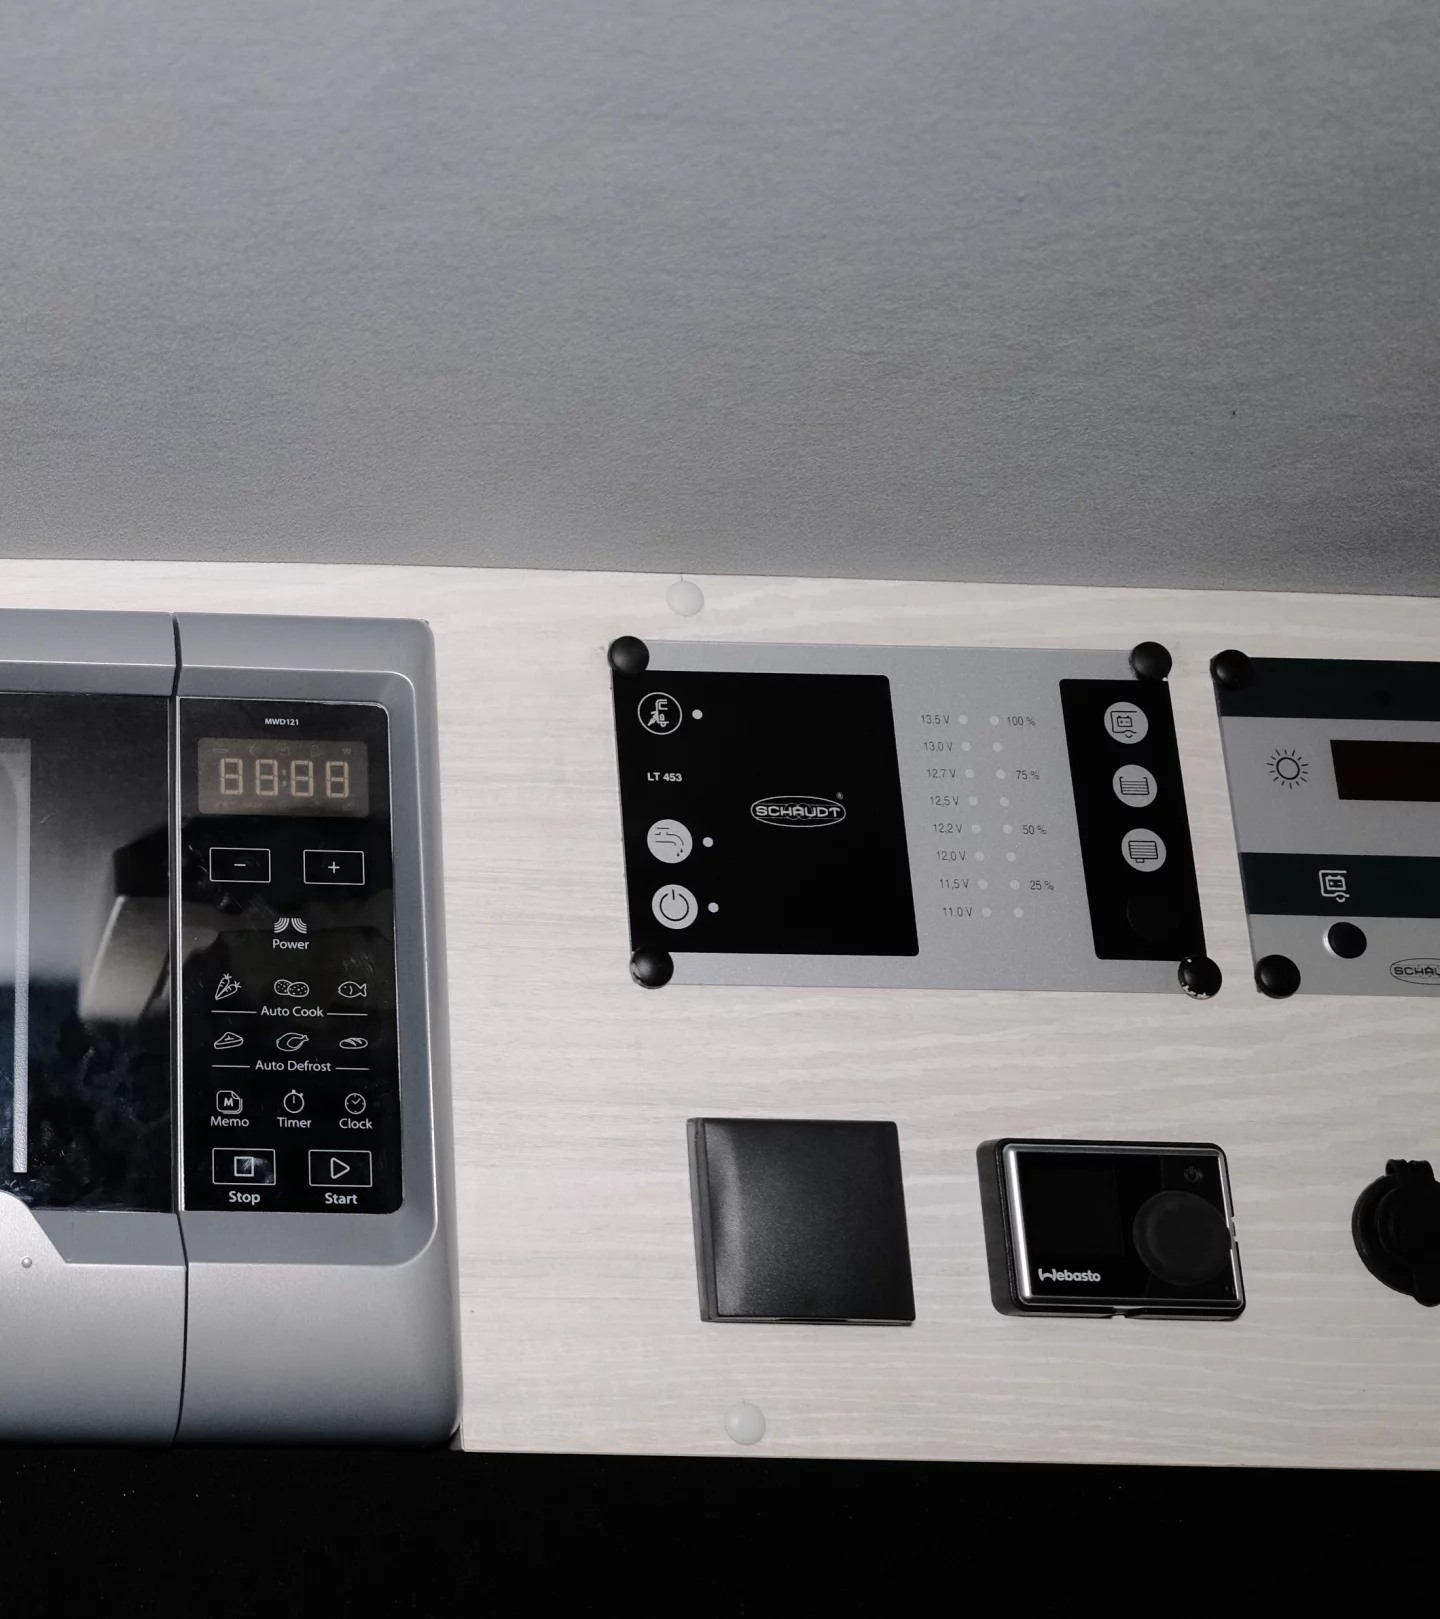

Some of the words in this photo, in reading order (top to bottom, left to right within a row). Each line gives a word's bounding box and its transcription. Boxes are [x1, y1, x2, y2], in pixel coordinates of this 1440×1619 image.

[264, 718, 299, 726] MWD121
[943, 714, 950, 724] V
[1007, 716, 1024, 726] 100
[1026, 717, 1036, 726] %
[946, 741, 953, 751] V
[647, 772, 660, 781] LT
[663, 773, 682, 782] 453
[949, 768, 956, 778] V
[1016, 770, 1028, 780] 75
[1030, 771, 1040, 780] %
[952, 796, 959, 805] V
[755, 805, 841, 818] SCHAUDT
[956, 823, 963, 833] V
[1022, 825, 1035, 835] 50
[1037, 826, 1047, 835] %
[959, 851, 966, 861] V
[962, 879, 969, 889] V
[1030, 880, 1042, 891] 25
[1044, 882, 1054, 891] %
[965, 907, 973, 917] V
[272, 938, 310, 950] Power
[260, 1006, 290, 1017] Auto
[292, 1006, 324, 1018] Cook
[255, 1060, 285, 1072] Auto
[287, 1060, 332, 1073] Defrost
[210, 1116, 250, 1127] Memo
[277, 1117, 312, 1129] Timer
[339, 1118, 373, 1130] Clock
[228, 1191, 261, 1206] Stop
[324, 1192, 358, 1205] Start
[1038, 1268, 1102, 1283] Webasto
